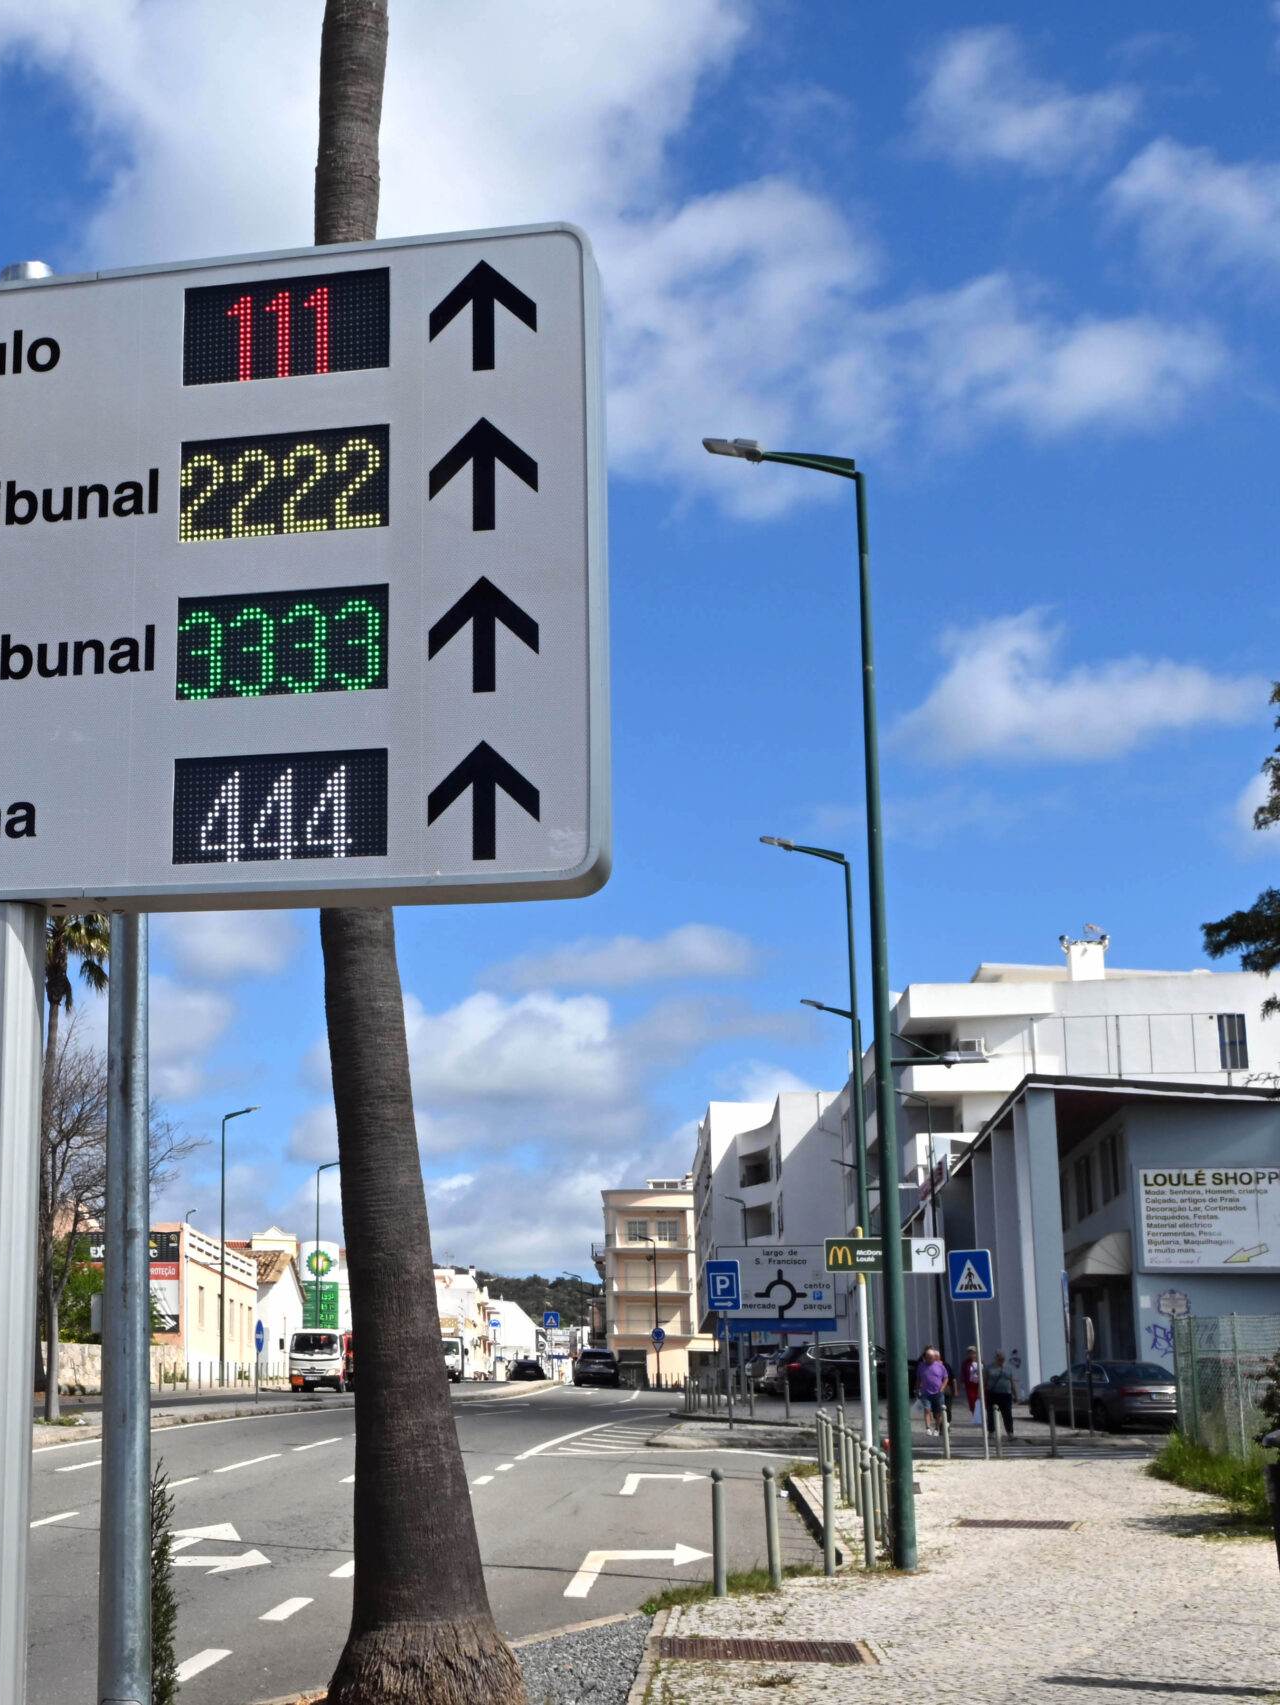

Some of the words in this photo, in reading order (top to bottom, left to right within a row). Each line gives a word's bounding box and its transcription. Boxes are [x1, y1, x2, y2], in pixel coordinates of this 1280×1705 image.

[226, 287, 329, 381] 111
[180, 437, 381, 543] 2222
[177, 599, 380, 700] 3333
[200, 764, 353, 863] 444
[1143, 1169, 1207, 1187] LOULÉ
[1211, 1171, 1280, 1186] SHOPP
[1169, 1188, 1204, 1196] Senhora,
[1204, 1188, 1237, 1196] Homem,
[1238, 1187, 1268, 1196] criança
[1145, 1197, 1179, 1205] Calçado,
[1180, 1197, 1206, 1205] artigos
[1145, 1205, 1187, 1213] Decoração
[1204, 1204, 1247, 1212] Cortinados
[1178, 1221, 1213, 1229] eléctrico
[763, 1248, 784, 1257] largo
[788, 1248, 798, 1256] de
[768, 1257, 807, 1265] Francisco
[149, 1266, 176, 1277] ROTEÇÃO
[804, 1282, 831, 1290] centro
[742, 1302, 776, 1310] mercado
[803, 1303, 832, 1312] parque
